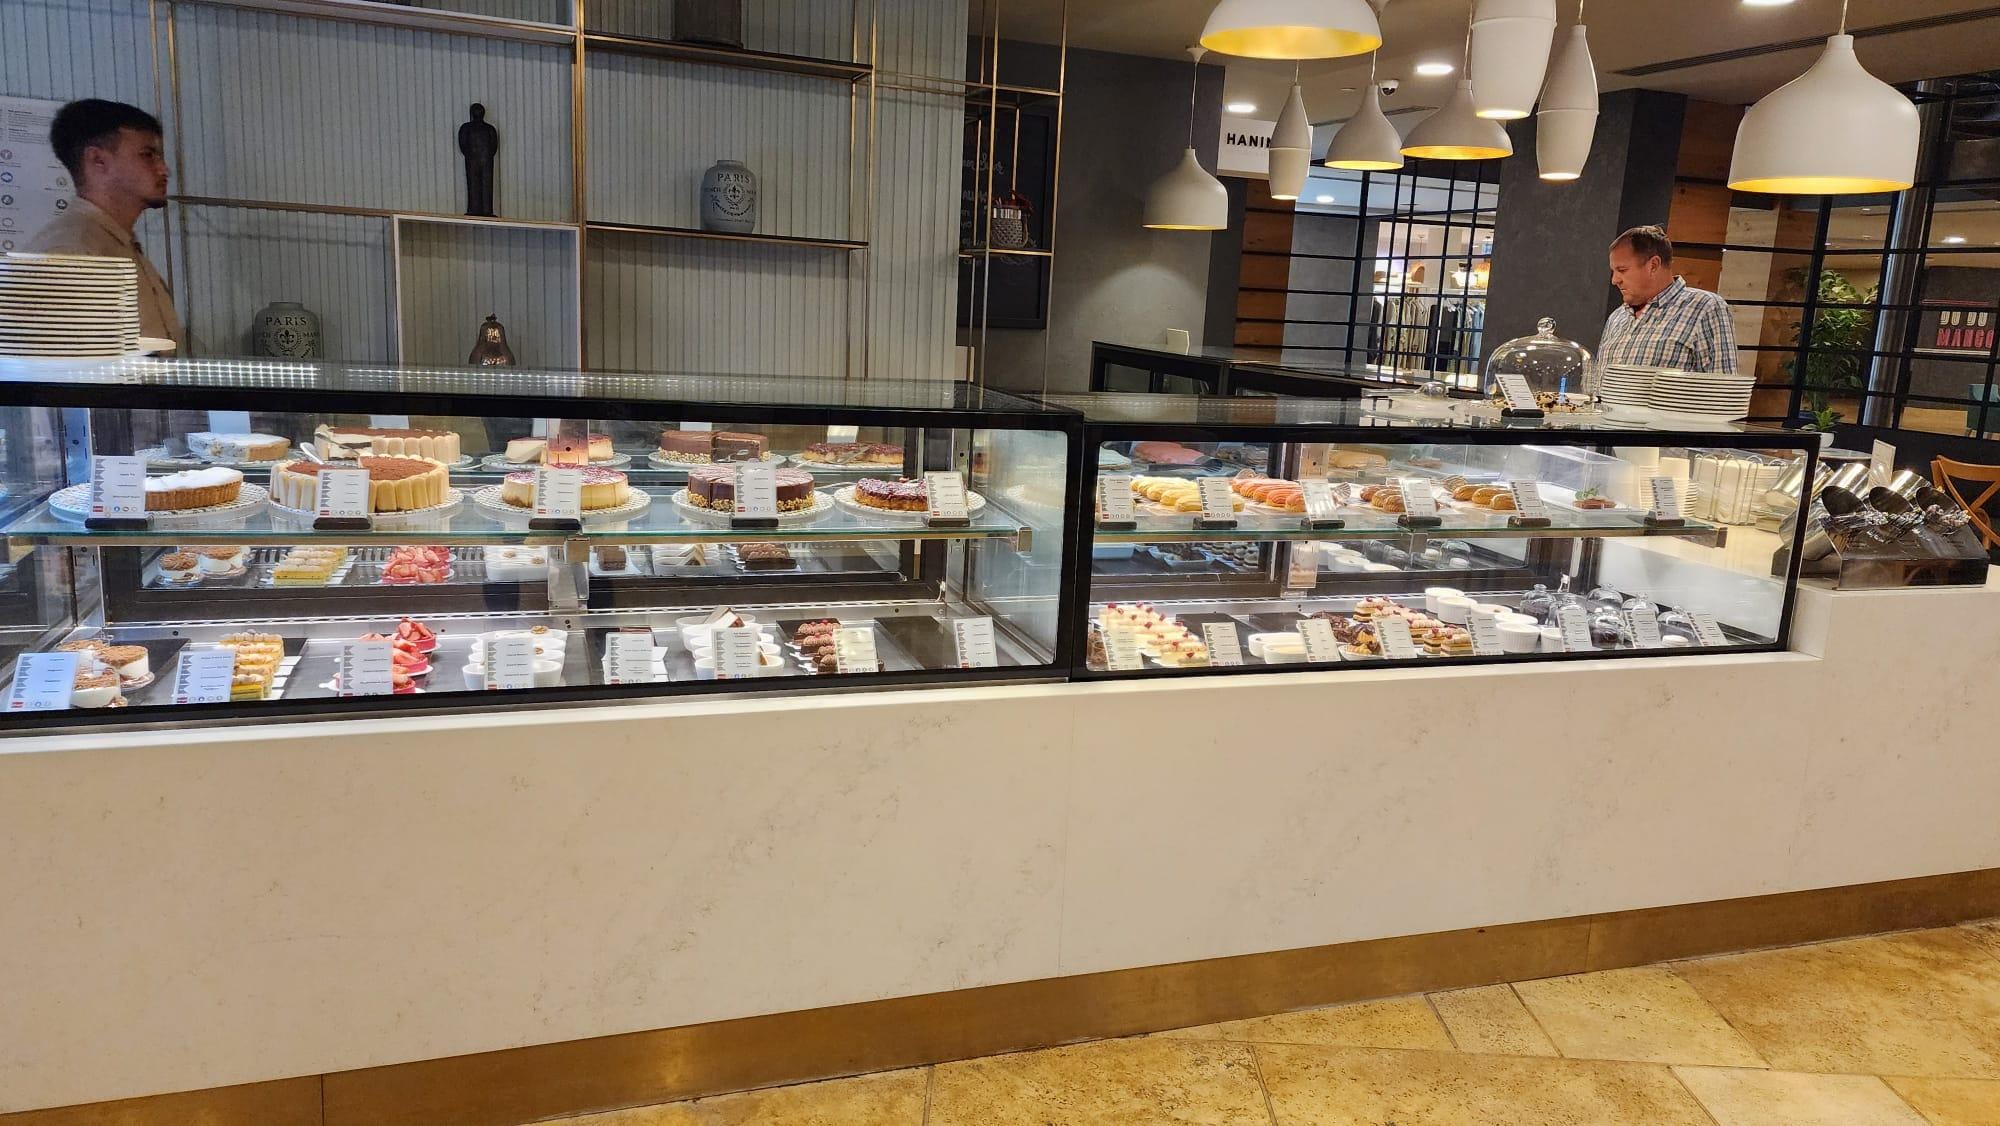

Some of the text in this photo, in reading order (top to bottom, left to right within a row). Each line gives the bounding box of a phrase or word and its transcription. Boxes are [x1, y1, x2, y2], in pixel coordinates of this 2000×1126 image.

[717, 173, 750, 183] PARIS
[265, 316, 307, 326] PARIS
[1936, 328, 1994, 348] MANGO
